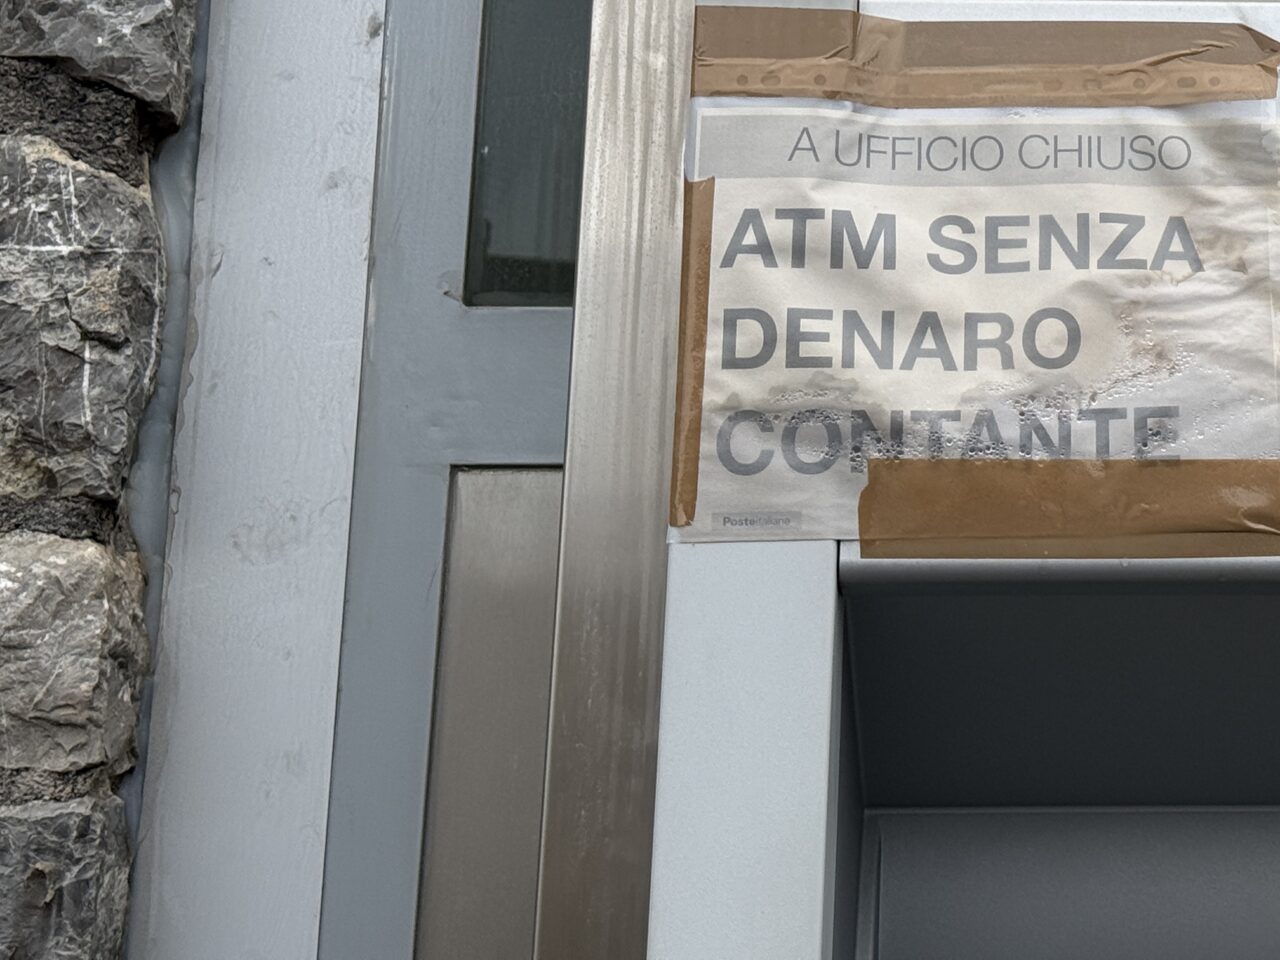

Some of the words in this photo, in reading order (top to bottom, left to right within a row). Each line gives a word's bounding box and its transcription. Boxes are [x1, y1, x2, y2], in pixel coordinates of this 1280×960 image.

[787, 127, 819, 163] A
[834, 133, 1004, 172] UFFICIO
[1018, 133, 1192, 171] CHIUSO
[719, 208, 896, 270] ATM
[927, 212, 1205, 275] SENZA
[721, 308, 1081, 372] DENARO
[716, 405, 1180, 476] CONTANTE
